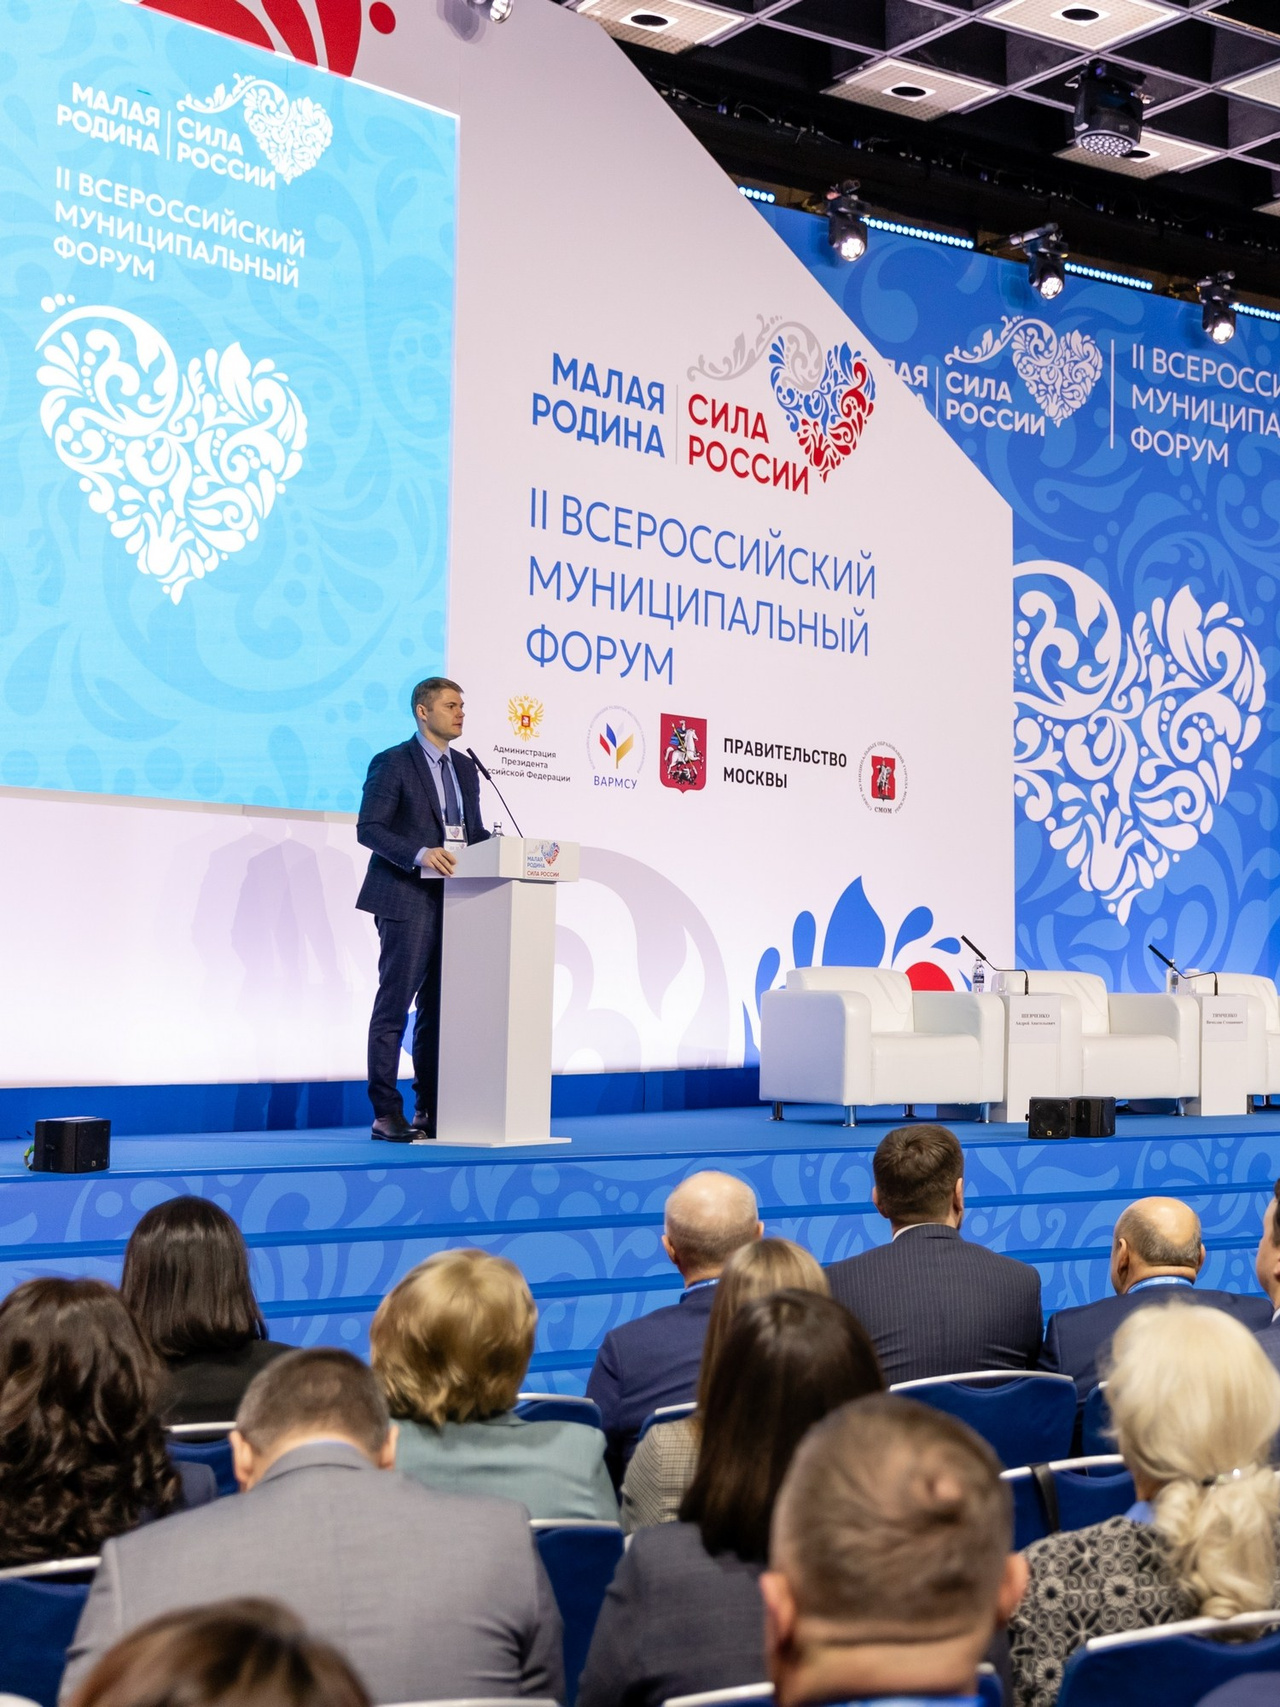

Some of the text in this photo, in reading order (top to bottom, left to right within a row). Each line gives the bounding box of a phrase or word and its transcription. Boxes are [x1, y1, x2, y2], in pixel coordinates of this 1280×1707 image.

[72, 82, 160, 129] МАЛАЯ
[57, 105, 160, 155] РОДИНА
[177, 117, 244, 156] СИЛА
[177, 142, 276, 190] РОССИИ
[55, 166, 305, 258] II ВСЕРОССИЙСКИЙ
[53, 235, 155, 281] ФОРУМ
[55, 201, 299, 288] МУНИЦИПАЛЬНЫЙ
[1132, 343, 1143, 372] II
[552, 352, 665, 415] МАЛАЯ
[946, 371, 1013, 404] СИЛА
[532, 392, 665, 458] РОДИНА
[688, 393, 769, 444] СИЛА
[946, 399, 1046, 437] РОССИИ
[689, 434, 809, 495] РОССИИ
[1131, 425, 1229, 467] ФОРУМ
[530, 487, 876, 600] II ВСЕРОССИЙСКИЙ
[529, 555, 869, 656] МУНИЦИПАЛЬНЫЙ
[526, 624, 673, 685] ФОРУМ
[493, 745, 556, 758] Администрация
[501, 757, 548, 769] Президента
[723, 737, 848, 768] ПРАВИТЕЛЬСТВО
[526, 770, 571, 782] Федерации
[593, 775, 637, 789] ВАРМСУ
[723, 769, 788, 789] МОСКВЫ
